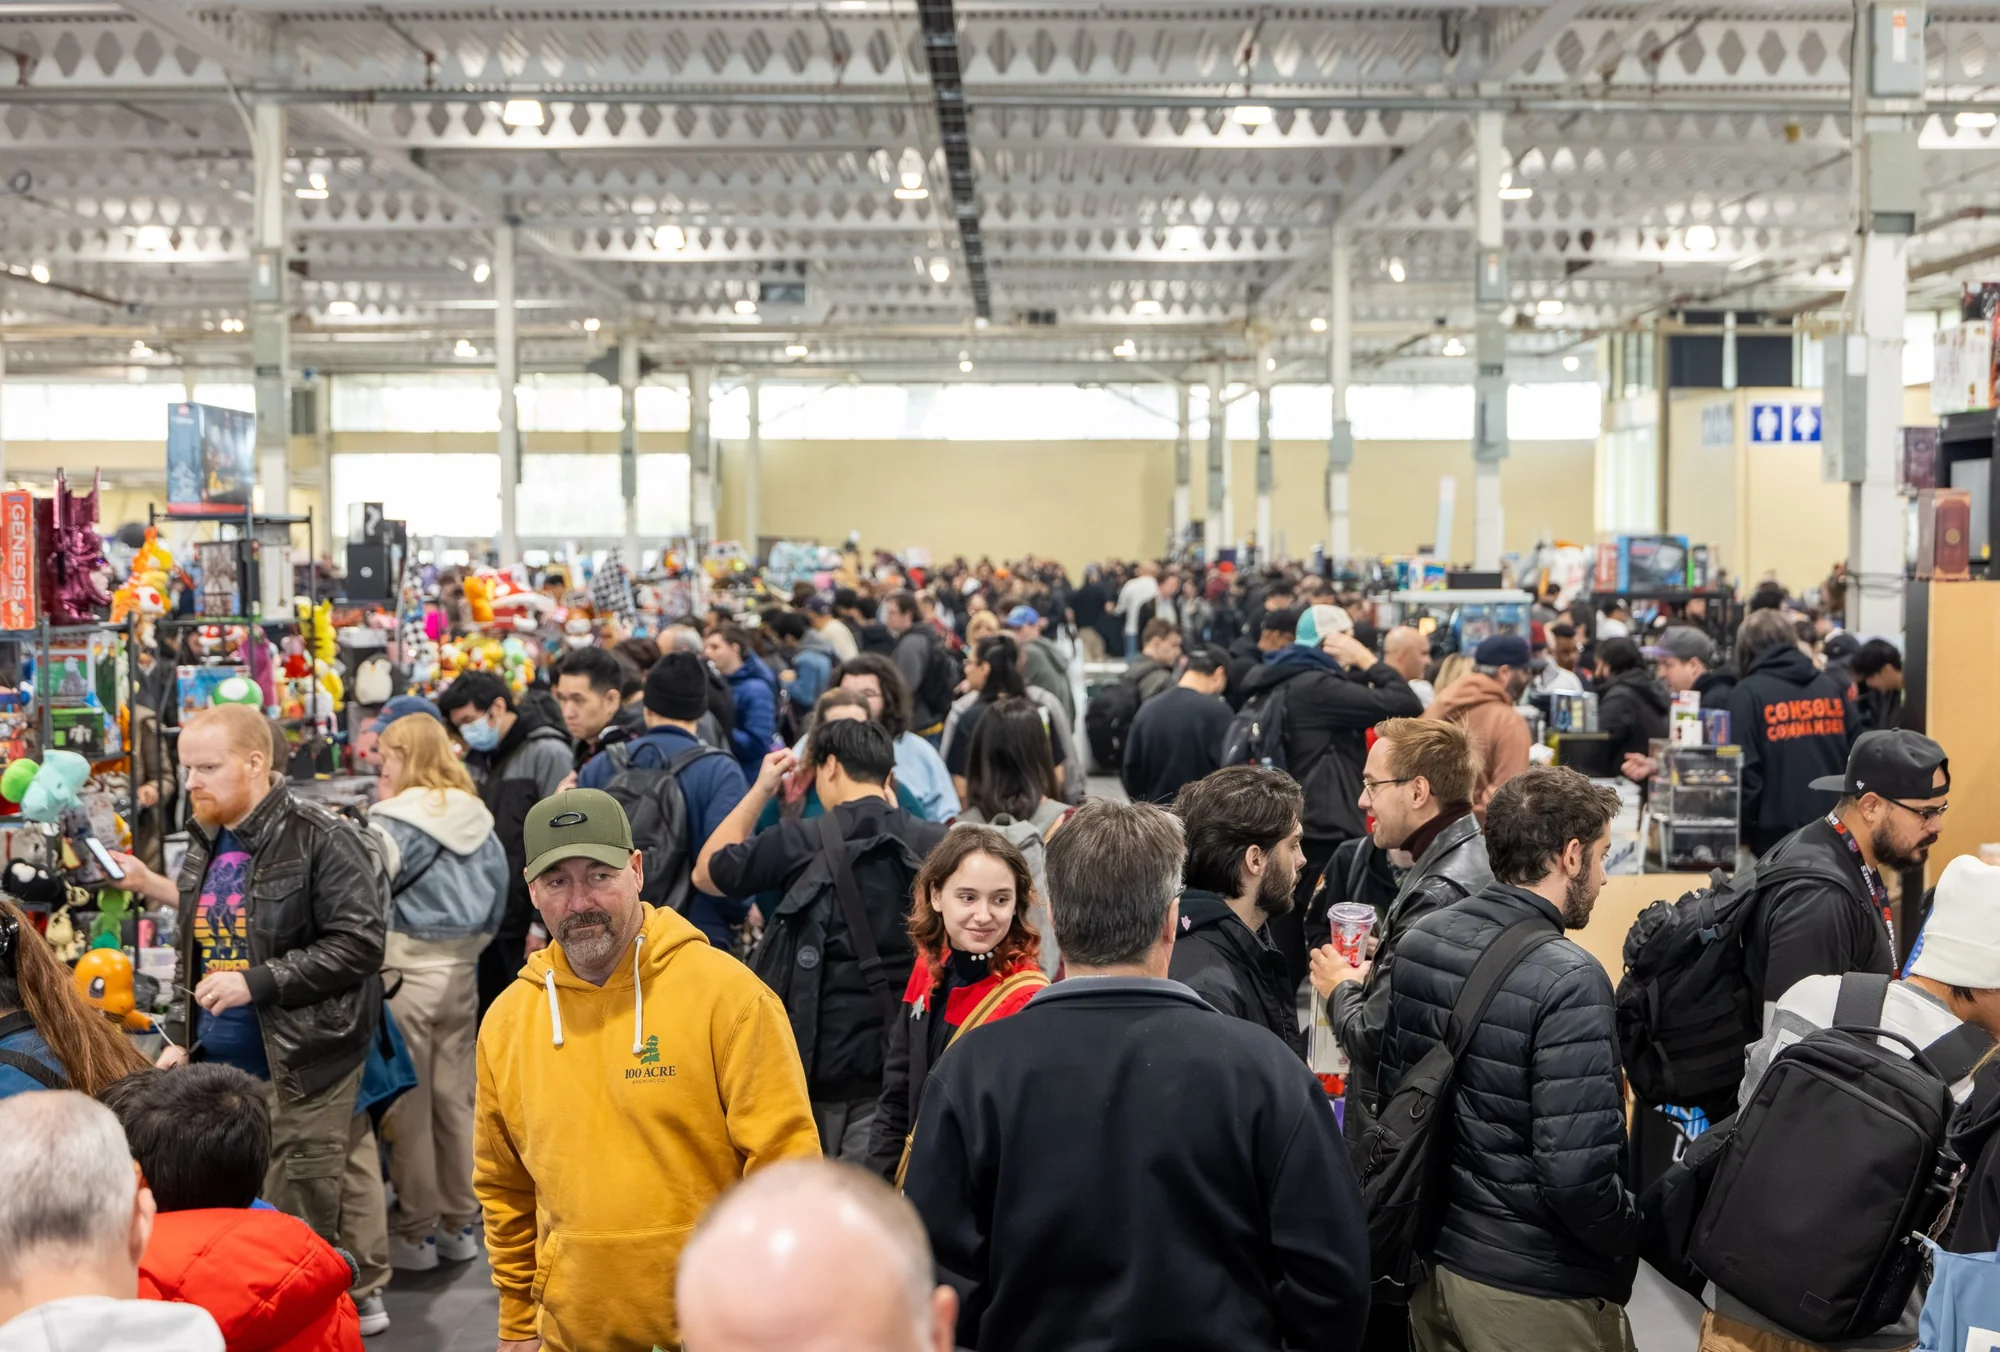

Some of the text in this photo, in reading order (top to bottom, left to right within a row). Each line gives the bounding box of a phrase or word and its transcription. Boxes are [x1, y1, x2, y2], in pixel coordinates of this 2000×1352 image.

[11, 503, 26, 600] GENESIS
[1764, 698, 1844, 724] CONSOLE
[625, 1065, 676, 1079] 100 ACRE
